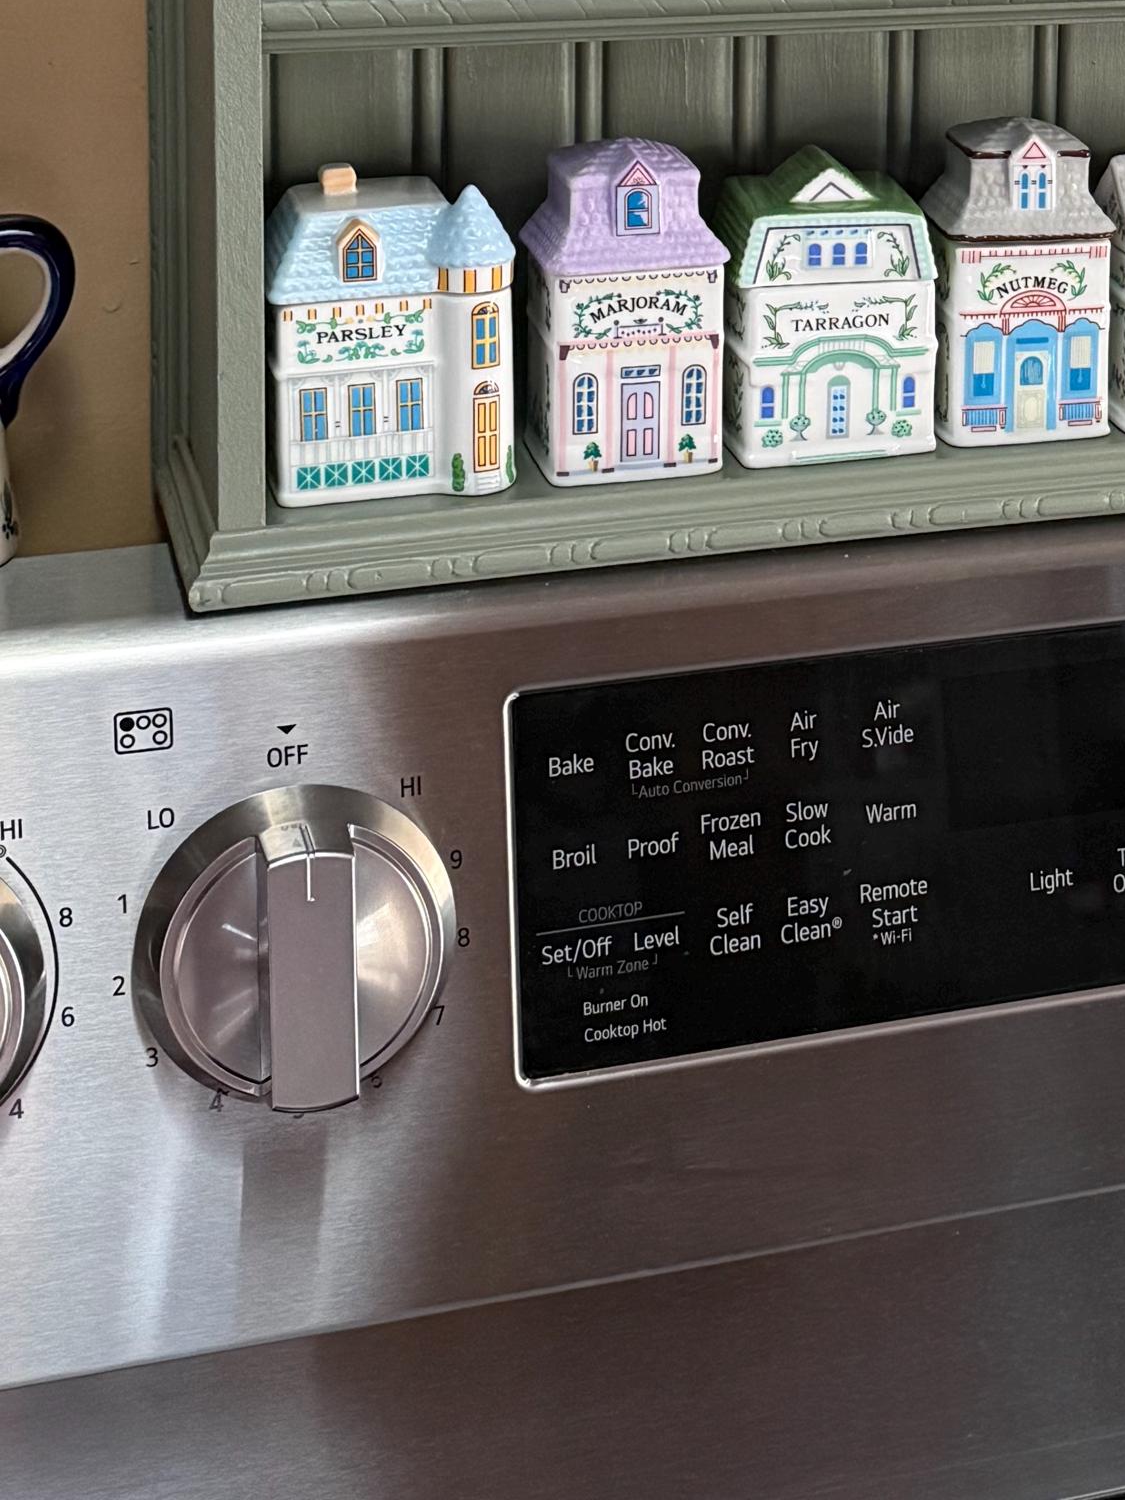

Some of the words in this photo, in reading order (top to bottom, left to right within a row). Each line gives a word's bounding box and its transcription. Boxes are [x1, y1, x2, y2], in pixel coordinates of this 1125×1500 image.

[996, 276, 1069, 299] NUTMEG
[590, 296, 689, 324] MARJORAM
[791, 313, 890, 332] TARRAGON
[316, 324, 407, 345] PARSLEY
[790, 710, 817, 731] Air
[874, 700, 900, 721] Air
[625, 733, 676, 753] Conv.
[702, 722, 752, 743] Conv.
[862, 725, 914, 748] S.Vide
[267, 744, 309, 768] OFF
[701, 746, 755, 770] Roast
[790, 737, 819, 761] Fry
[548, 754, 595, 777] Bake
[628, 757, 674, 779] Bake
[401, 776, 422, 797] HI
[639, 782, 670, 799] Auto
[673, 772, 743, 794] Conversion
[147, 807, 175, 830] LO
[700, 810, 762, 834] Frozen
[785, 799, 829, 823] Slow
[866, 802, 918, 824] Warm
[0, 819, 23, 841] HI
[785, 824, 832, 849] Cook
[552, 844, 597, 870] Broil
[627, 832, 680, 860] Proof
[709, 836, 754, 861] Meal
[450, 850, 463, 870] 9
[859, 877, 928, 904] Remote
[1030, 867, 1073, 894] Light
[117, 894, 128, 914] 1
[578, 901, 643, 923] COOKTOP
[787, 894, 829, 918] Easy
[59, 907, 73, 927] 8
[716, 903, 753, 929] Self
[872, 904, 918, 930] Start
[457, 927, 470, 947] 8
[541, 936, 613, 966] Set/Off
[634, 925, 680, 952] Level
[709, 931, 762, 957] Clean
[576, 962, 613, 980] Warm
[617, 957, 649, 974] Zone
[112, 976, 126, 997] 2
[433, 1005, 445, 1026] 7
[583, 997, 626, 1016] Burner
[629, 994, 649, 1008] On
[61, 1007, 75, 1027] 6
[584, 1022, 639, 1043] Cooktop
[643, 1018, 667, 1033] Hot
[146, 1048, 159, 1068] 3
[9, 1099, 24, 1119] 4
